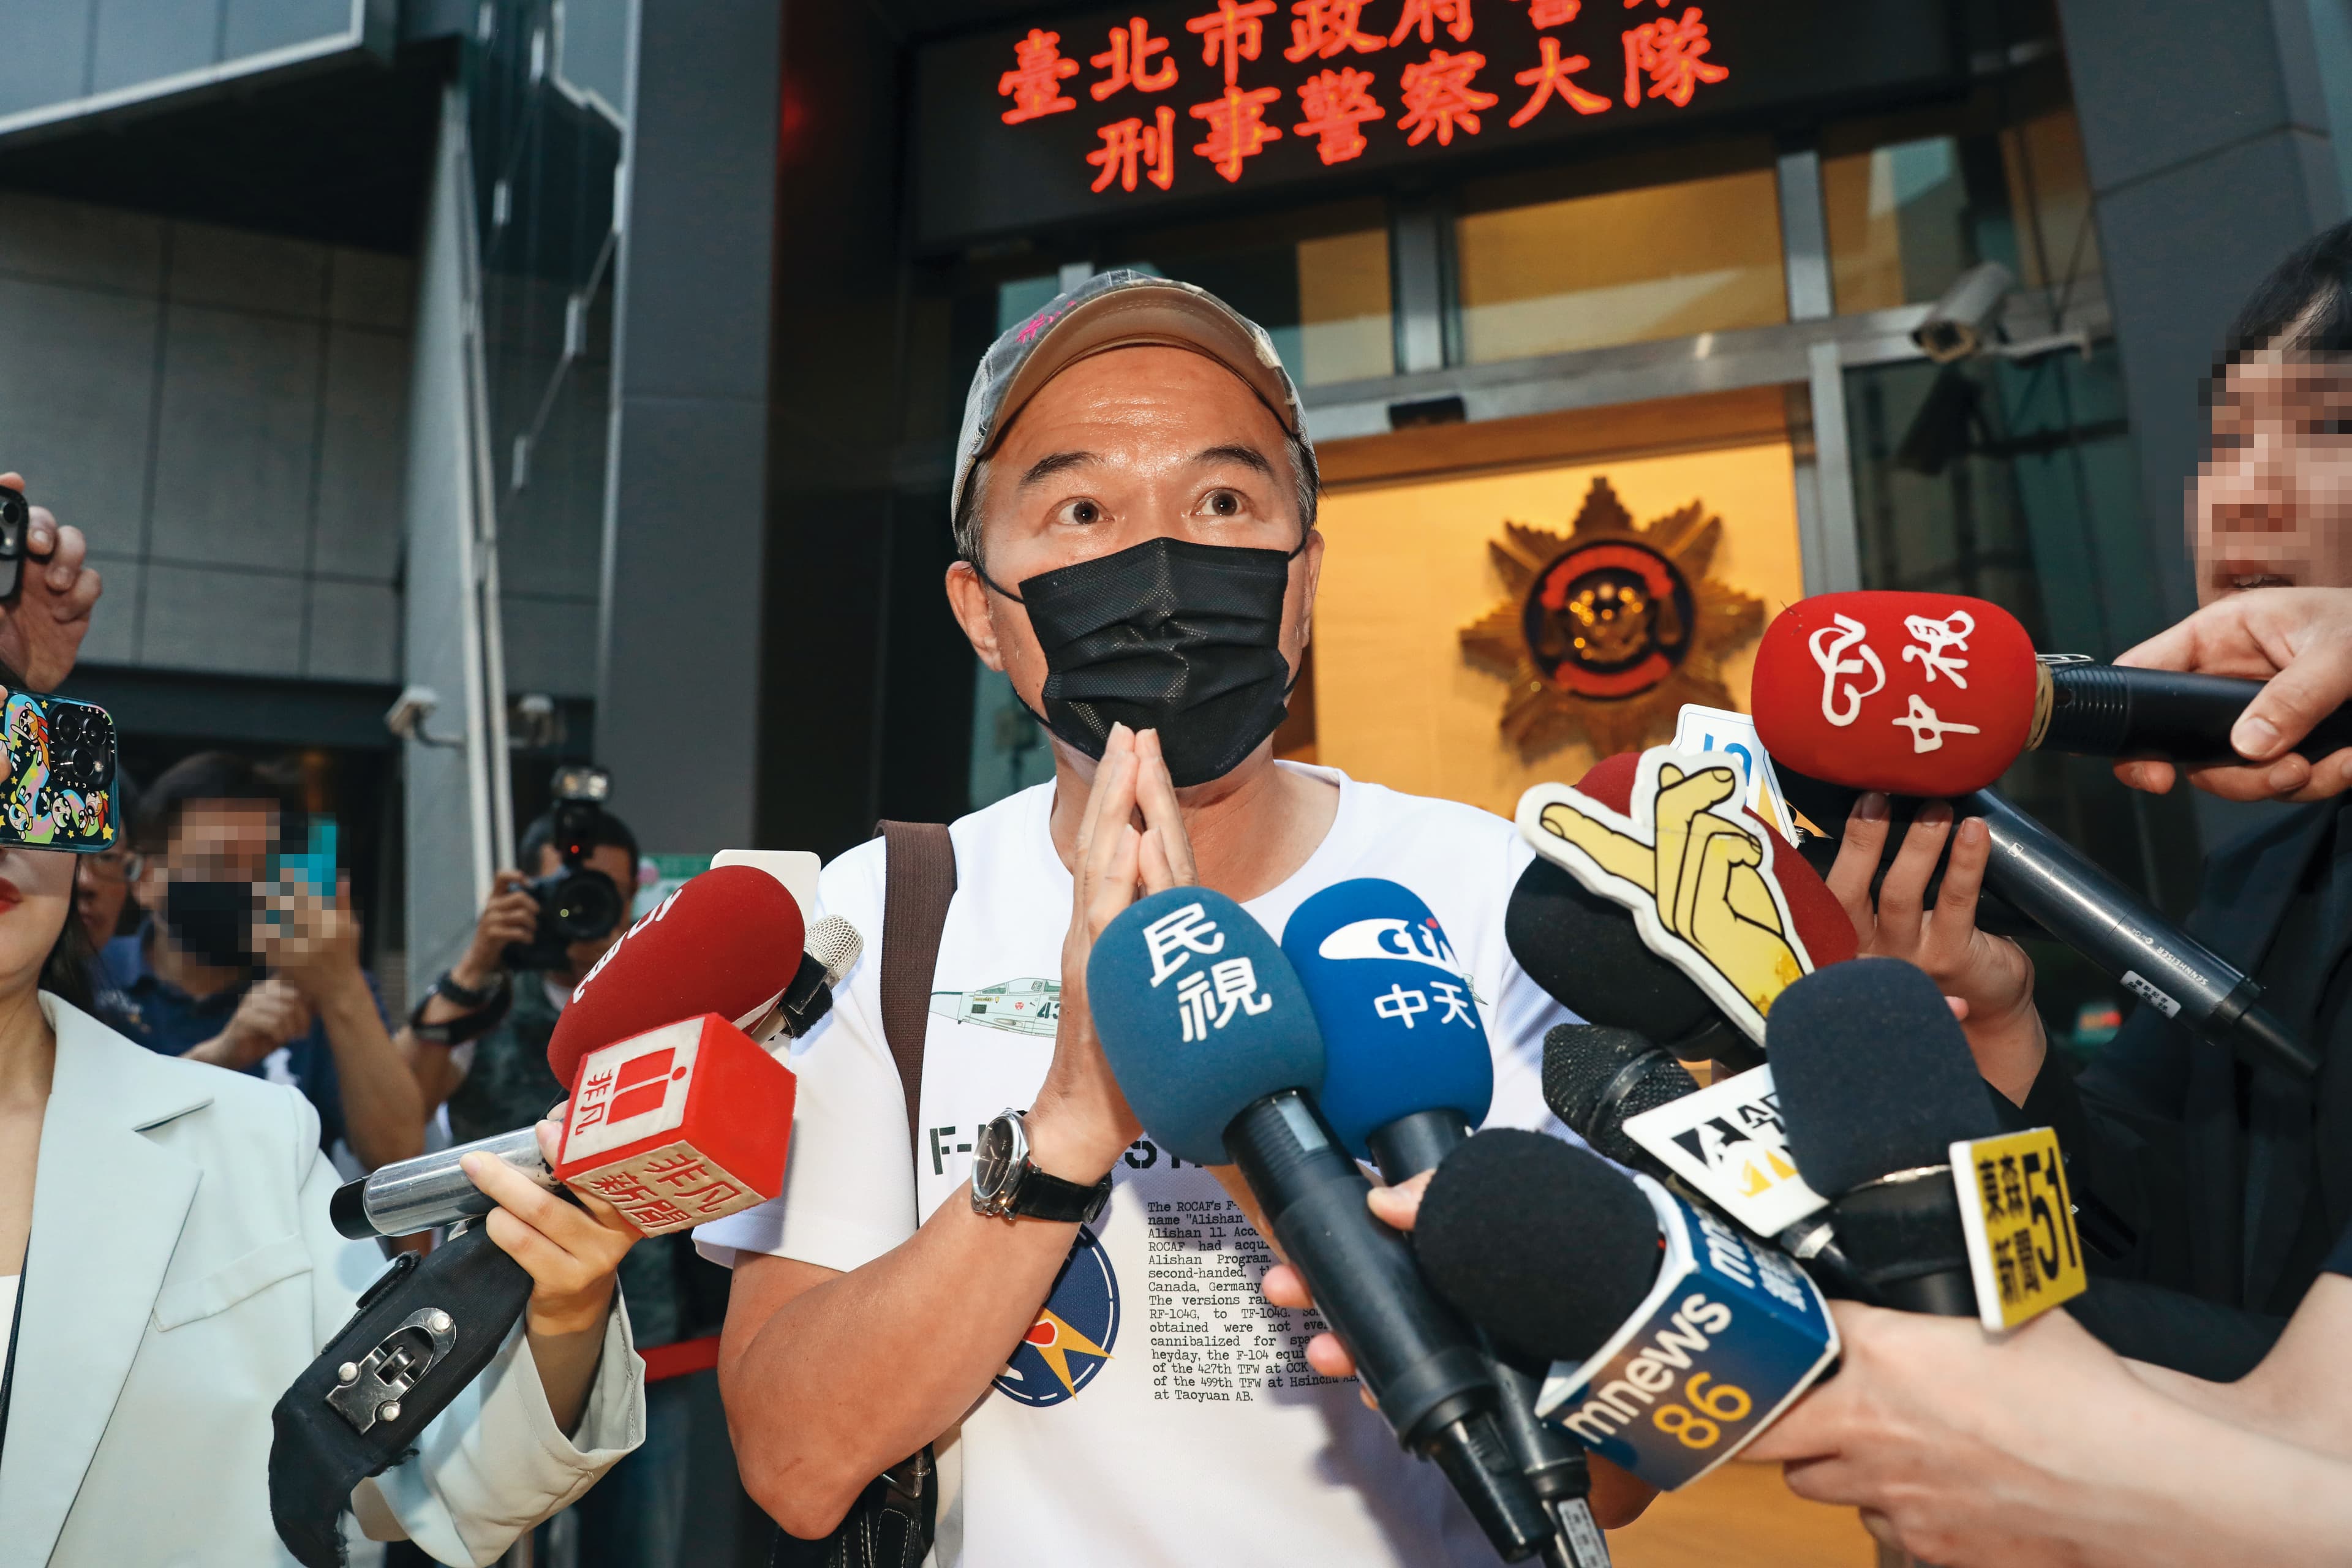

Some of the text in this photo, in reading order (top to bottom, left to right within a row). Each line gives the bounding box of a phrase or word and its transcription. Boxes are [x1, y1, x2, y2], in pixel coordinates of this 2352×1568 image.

[999, 0, 1676, 124] 臺北市政府
[1086, 7, 1729, 193] 刑事警察大隊
[1142, 902, 1273, 1042] 民視
[2157, 946, 2209, 986] SENNHEISER
[1374, 981, 1476, 1029] 中天
[575, 1068, 614, 1136] 非凡
[643, 1153, 742, 1213] 非凡
[1148, 1202, 1171, 1212] The
[1177, 1200, 1221, 1212] ROCAF's
[2022, 1146, 2077, 1281] 51
[1148, 1216, 1180, 1225] name
[1148, 1227, 1201, 1238] Alishan
[1148, 1242, 1185, 1251] ROCAF
[1199, 1240, 1222, 1251] had
[1148, 1254, 1272, 1267] Alishan Program.
[1148, 1267, 1246, 1278] second-handed,
[1148, 1281, 1199, 1293] Canada,
[1149, 1295, 1172, 1305] The
[1182, 1295, 1240, 1305] versions
[1150, 1308, 1199, 1320] RF-104G,
[1214, 1309, 1227, 1318] to
[1242, 1308, 1291, 1318] TF-104G.
[1150, 1322, 1209, 1333] obtained
[1224, 1324, 1253, 1332] were
[1268, 1322, 1291, 1332] not
[1151, 1335, 1314, 1347] cannibalized for spa
[1152, 1349, 1201, 1363] heyday,
[1207, 1350, 1229, 1360] the
[1237, 1349, 1269, 1360] F-104
[1153, 1362, 1309, 1374] of the 427th TFW at CCK
[1563, 1293, 1733, 1444] mnews
[1154, 1376, 1167, 1386] of
[1174, 1376, 1195, 1386] the
[1201, 1378, 1233, 1388] 499th
[1239, 1378, 1261, 1388] TFW
[1268, 1377, 1284, 1387] at
[1154, 1390, 1253, 1403] at Taoyuan AB.
[1652, 1371, 1752, 1450] 86
